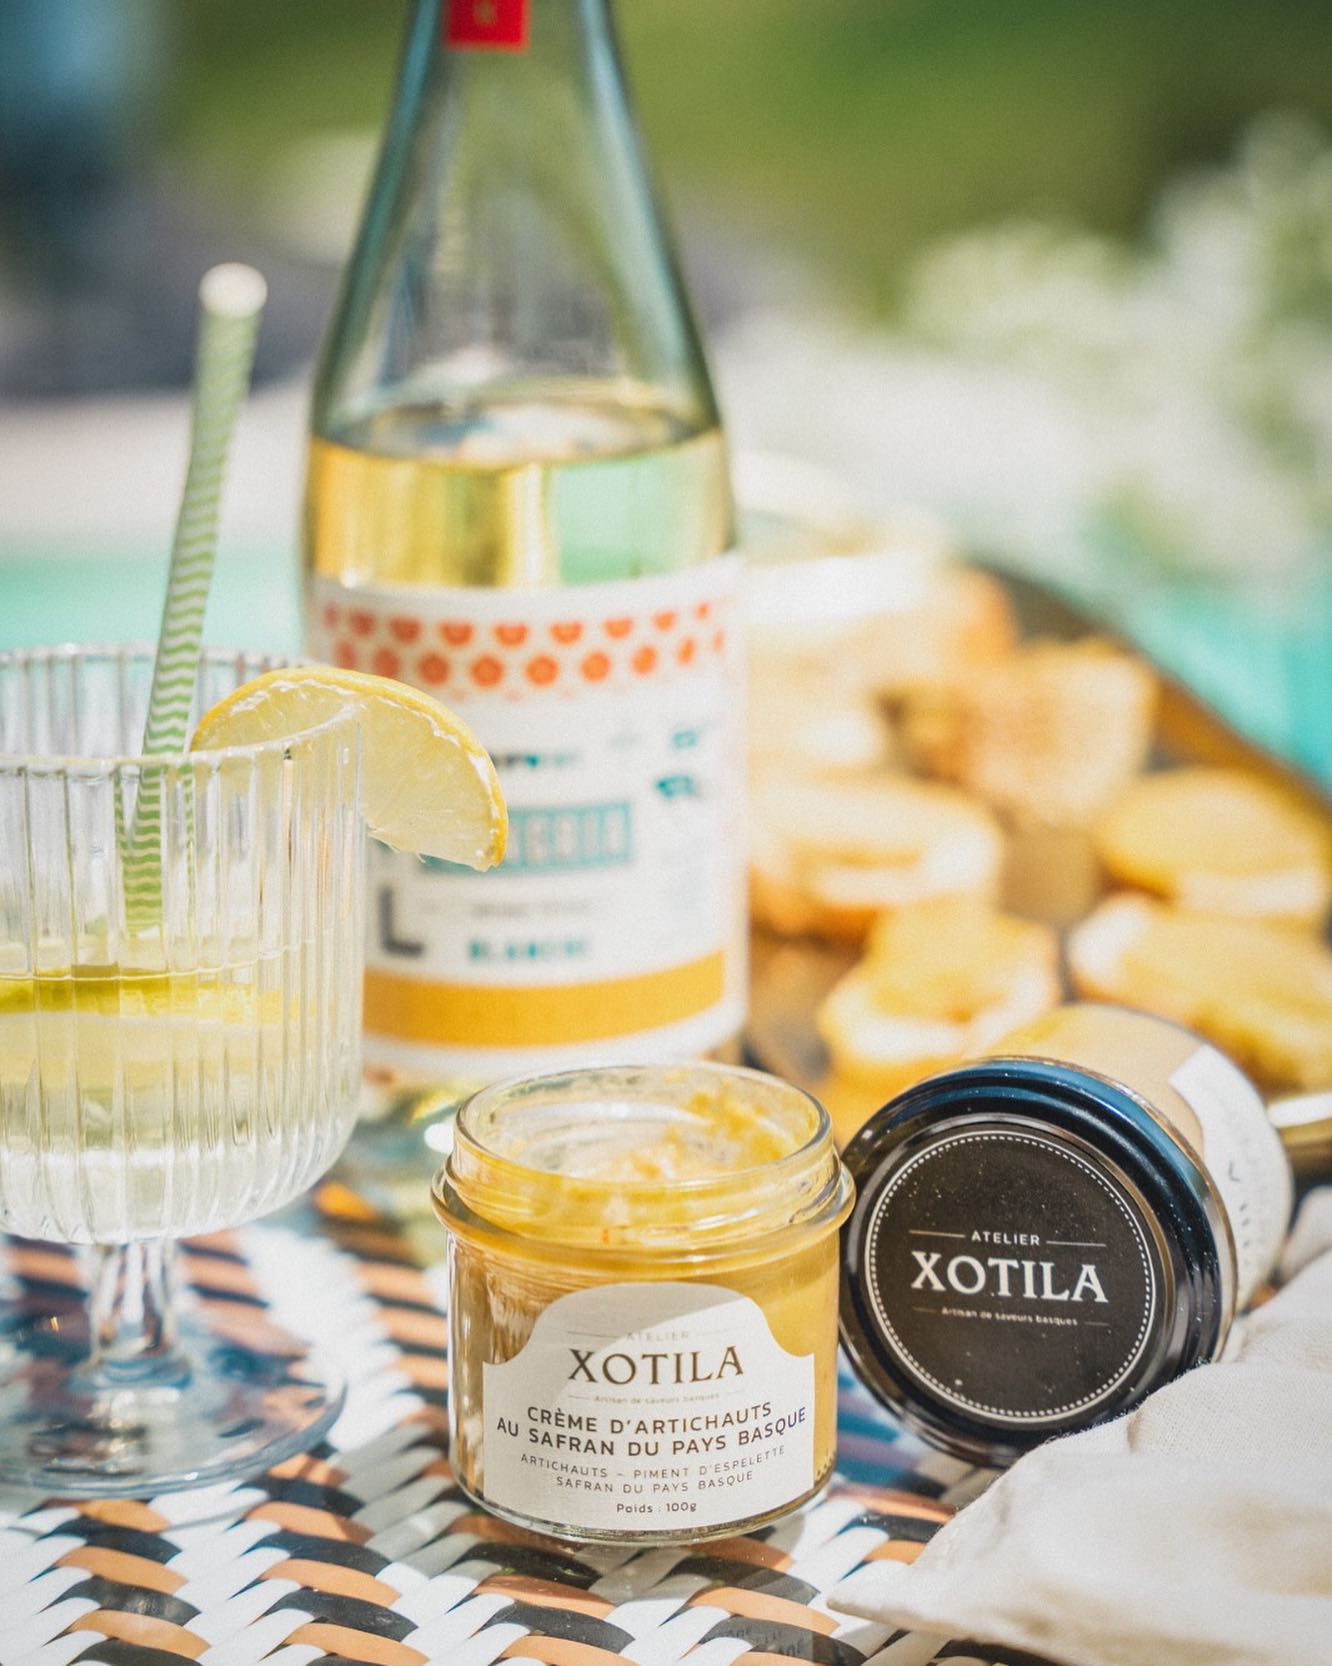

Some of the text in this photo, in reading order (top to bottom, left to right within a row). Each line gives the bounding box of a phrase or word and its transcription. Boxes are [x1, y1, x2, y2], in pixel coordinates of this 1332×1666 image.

[970, 1229, 1040, 1246] ATELIER
[910, 1250, 1109, 1303] XOTILA
[568, 1345, 744, 1386] XOTILA
[497, 1406, 806, 1457] AU SAFRAN DU PAYS BASQUE
[527, 1405, 597, 1433] CRÈME
[520, 1454, 608, 1478] ARTICHAUTS
[633, 1467, 689, 1480] PIMENT
[556, 1471, 753, 1494] SAFRAN DU PAYS BASQUE
[616, 1502, 654, 1514] Poids
[665, 1501, 697, 1514] 100g
